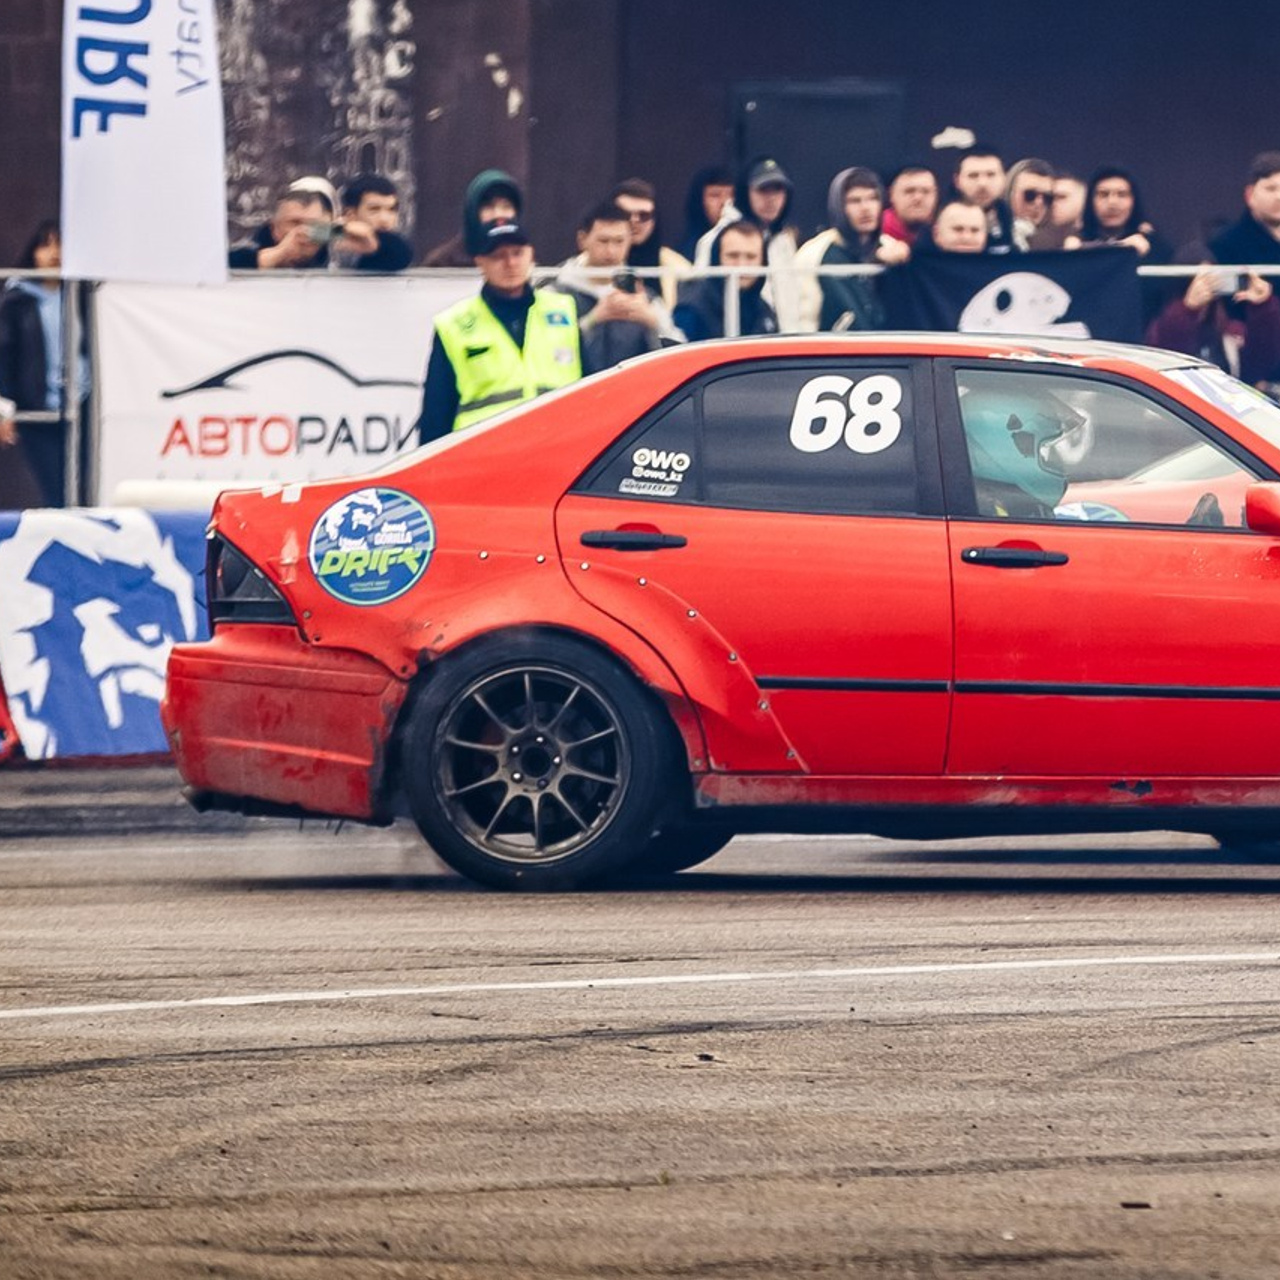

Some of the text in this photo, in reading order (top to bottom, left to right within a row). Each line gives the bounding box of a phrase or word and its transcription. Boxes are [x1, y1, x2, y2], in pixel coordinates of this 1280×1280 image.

[789, 375, 902, 454] 68
[632, 447, 691, 472] OWO
[318, 546, 422, 578] DRIFT
